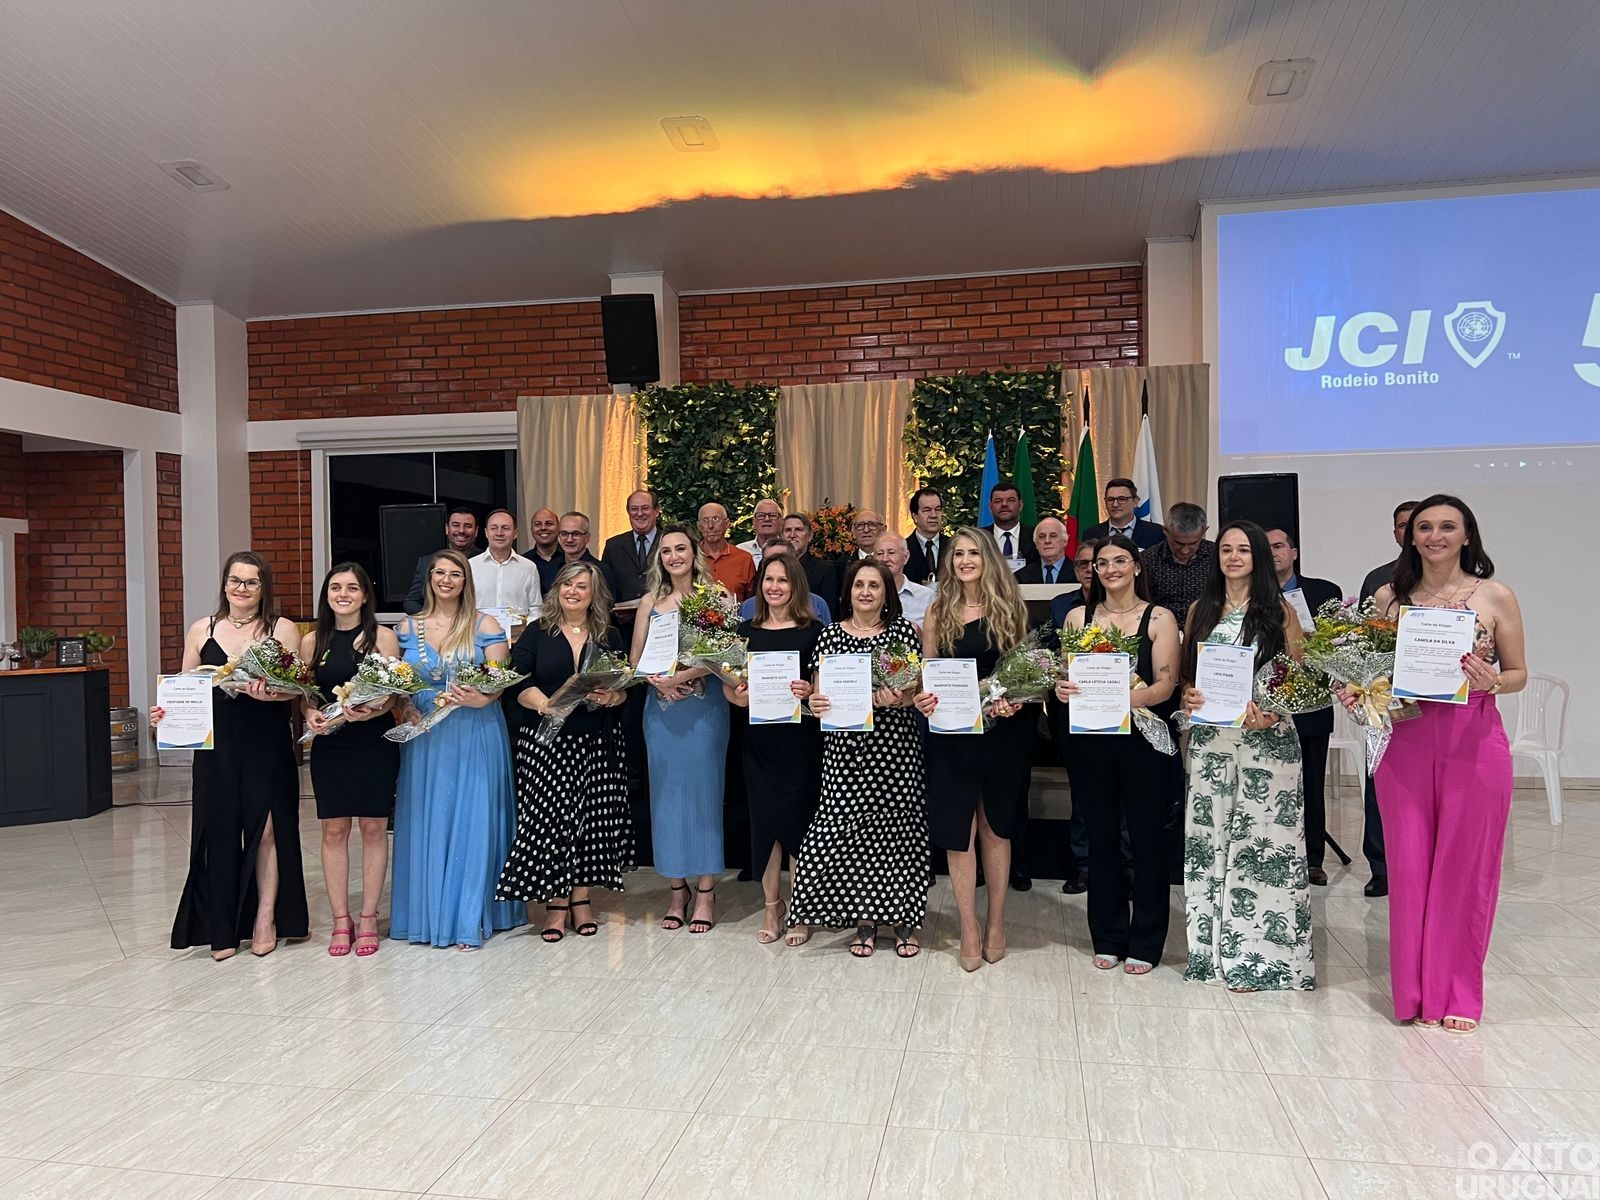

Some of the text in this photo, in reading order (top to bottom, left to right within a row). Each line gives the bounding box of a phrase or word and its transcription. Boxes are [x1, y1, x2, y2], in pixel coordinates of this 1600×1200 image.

[1285, 310, 1432, 371] JCI
[1321, 371, 1440, 389] Rodeio Bonito
